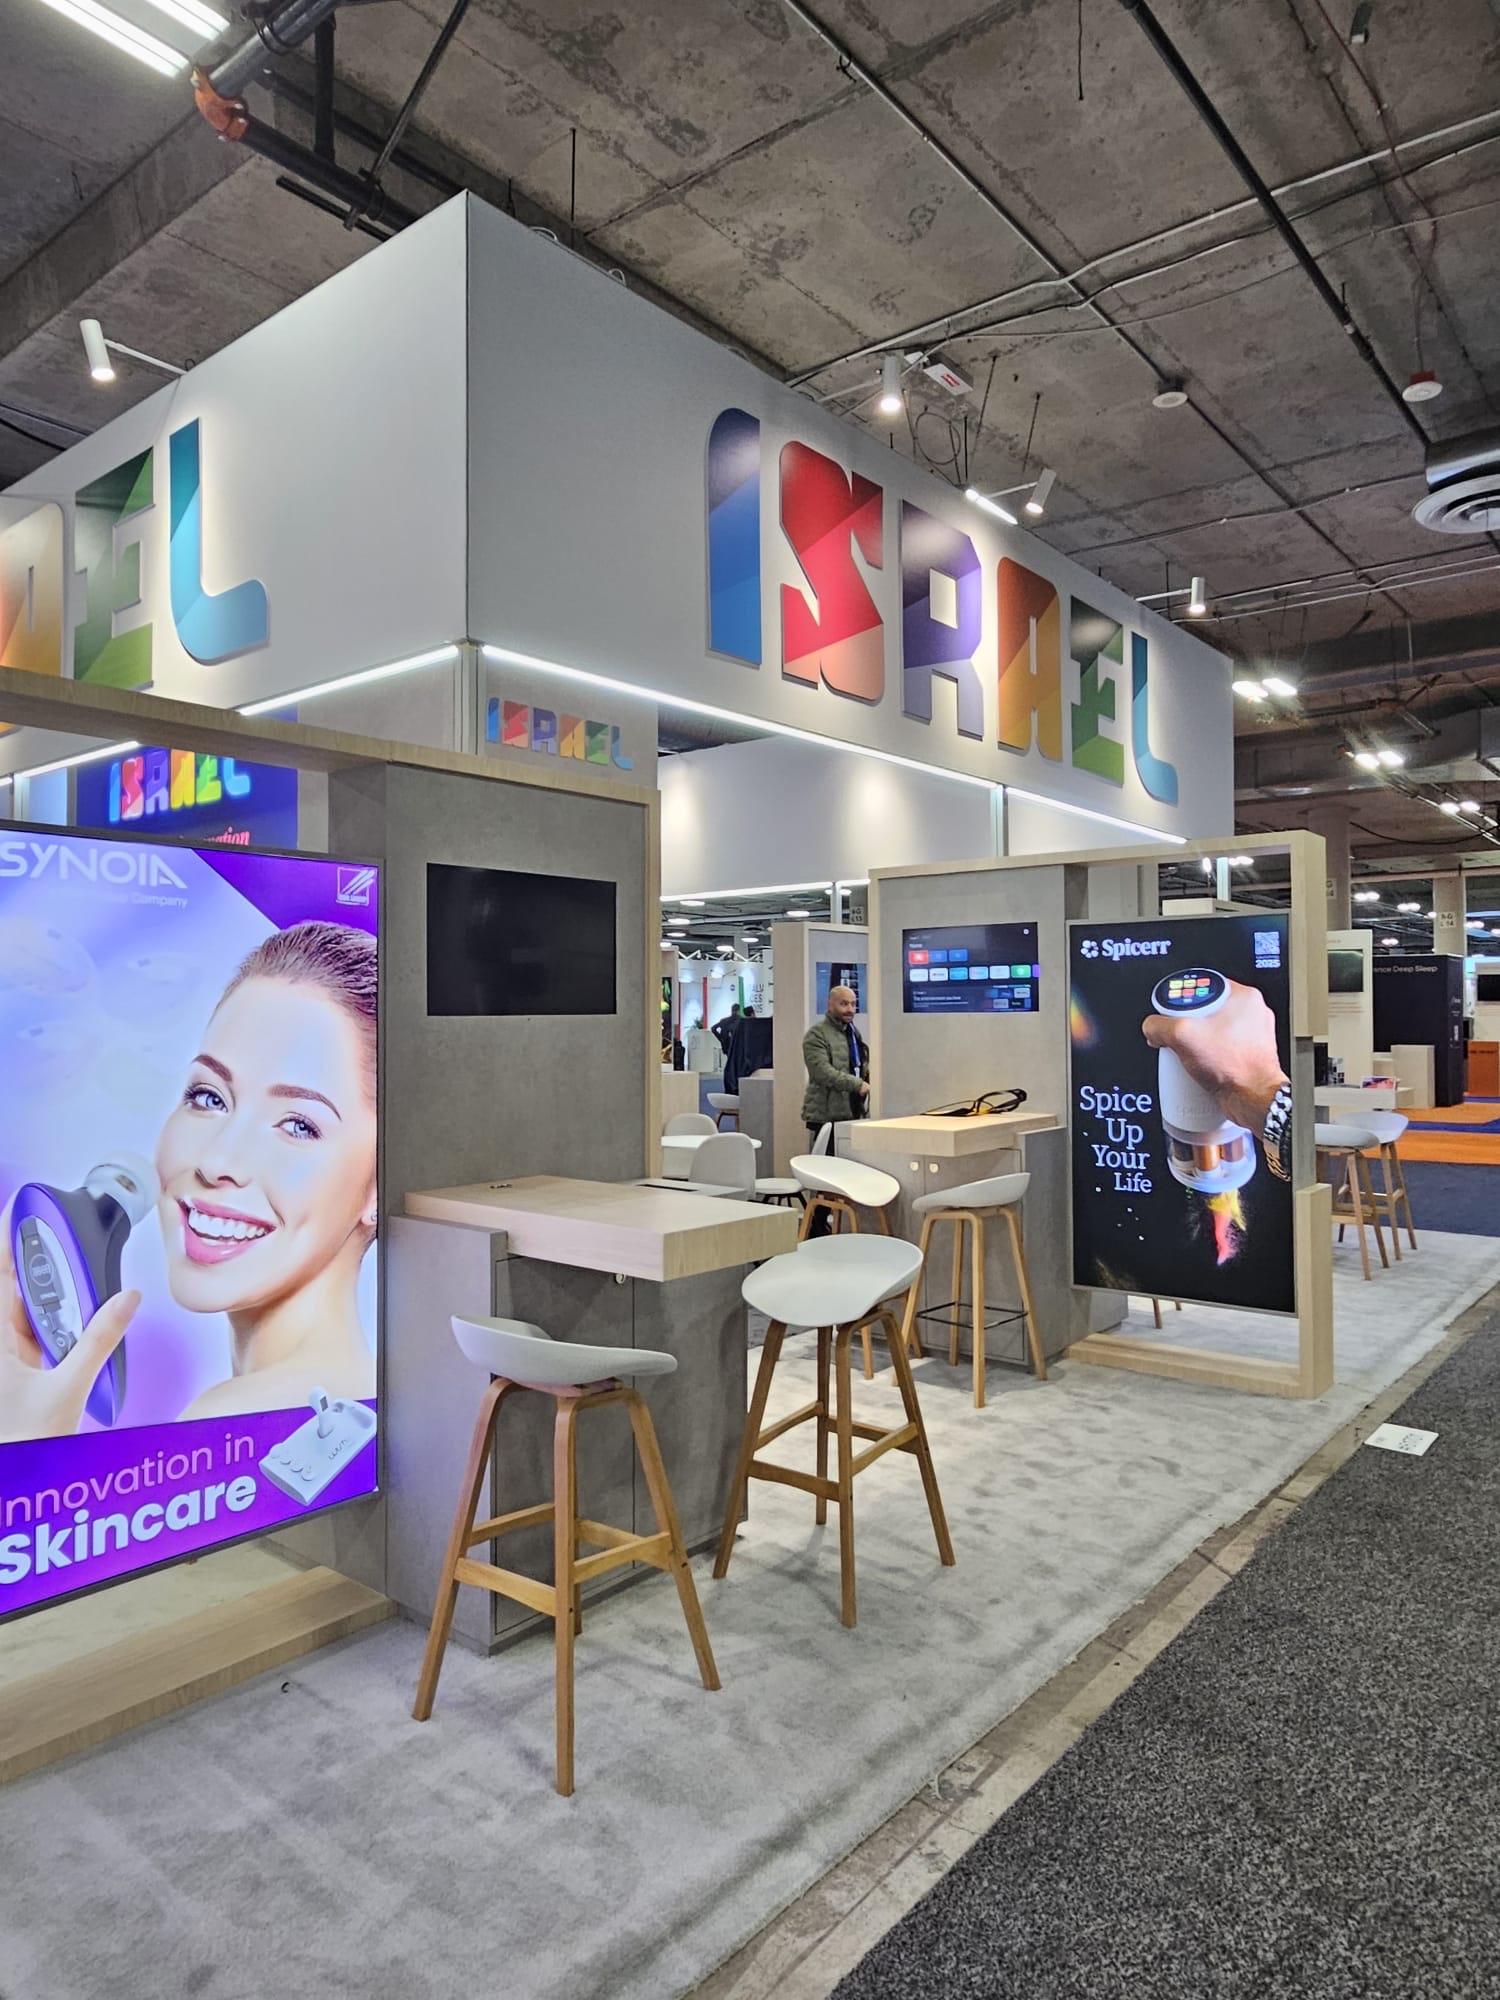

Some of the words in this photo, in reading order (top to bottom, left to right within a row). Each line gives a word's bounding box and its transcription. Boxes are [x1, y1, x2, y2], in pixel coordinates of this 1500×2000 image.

[0, 417, 270, 736] AEL
[706, 408, 1179, 805] ISRAEL
[486, 697, 635, 771] ISRAEL
[109, 748, 250, 822] ISRAEL
[1101, 938, 1172, 961] Spicerr
[1255, 959, 1281, 968] 2025
[1080, 1086, 1152, 1118] Spice
[1106, 1118, 1144, 1150] Up
[1091, 1144, 1151, 1170] Your
[1114, 1172, 1152, 1193] Life
[225, 1433, 254, 1465] in
[0, 1475, 257, 1585] Skincare
